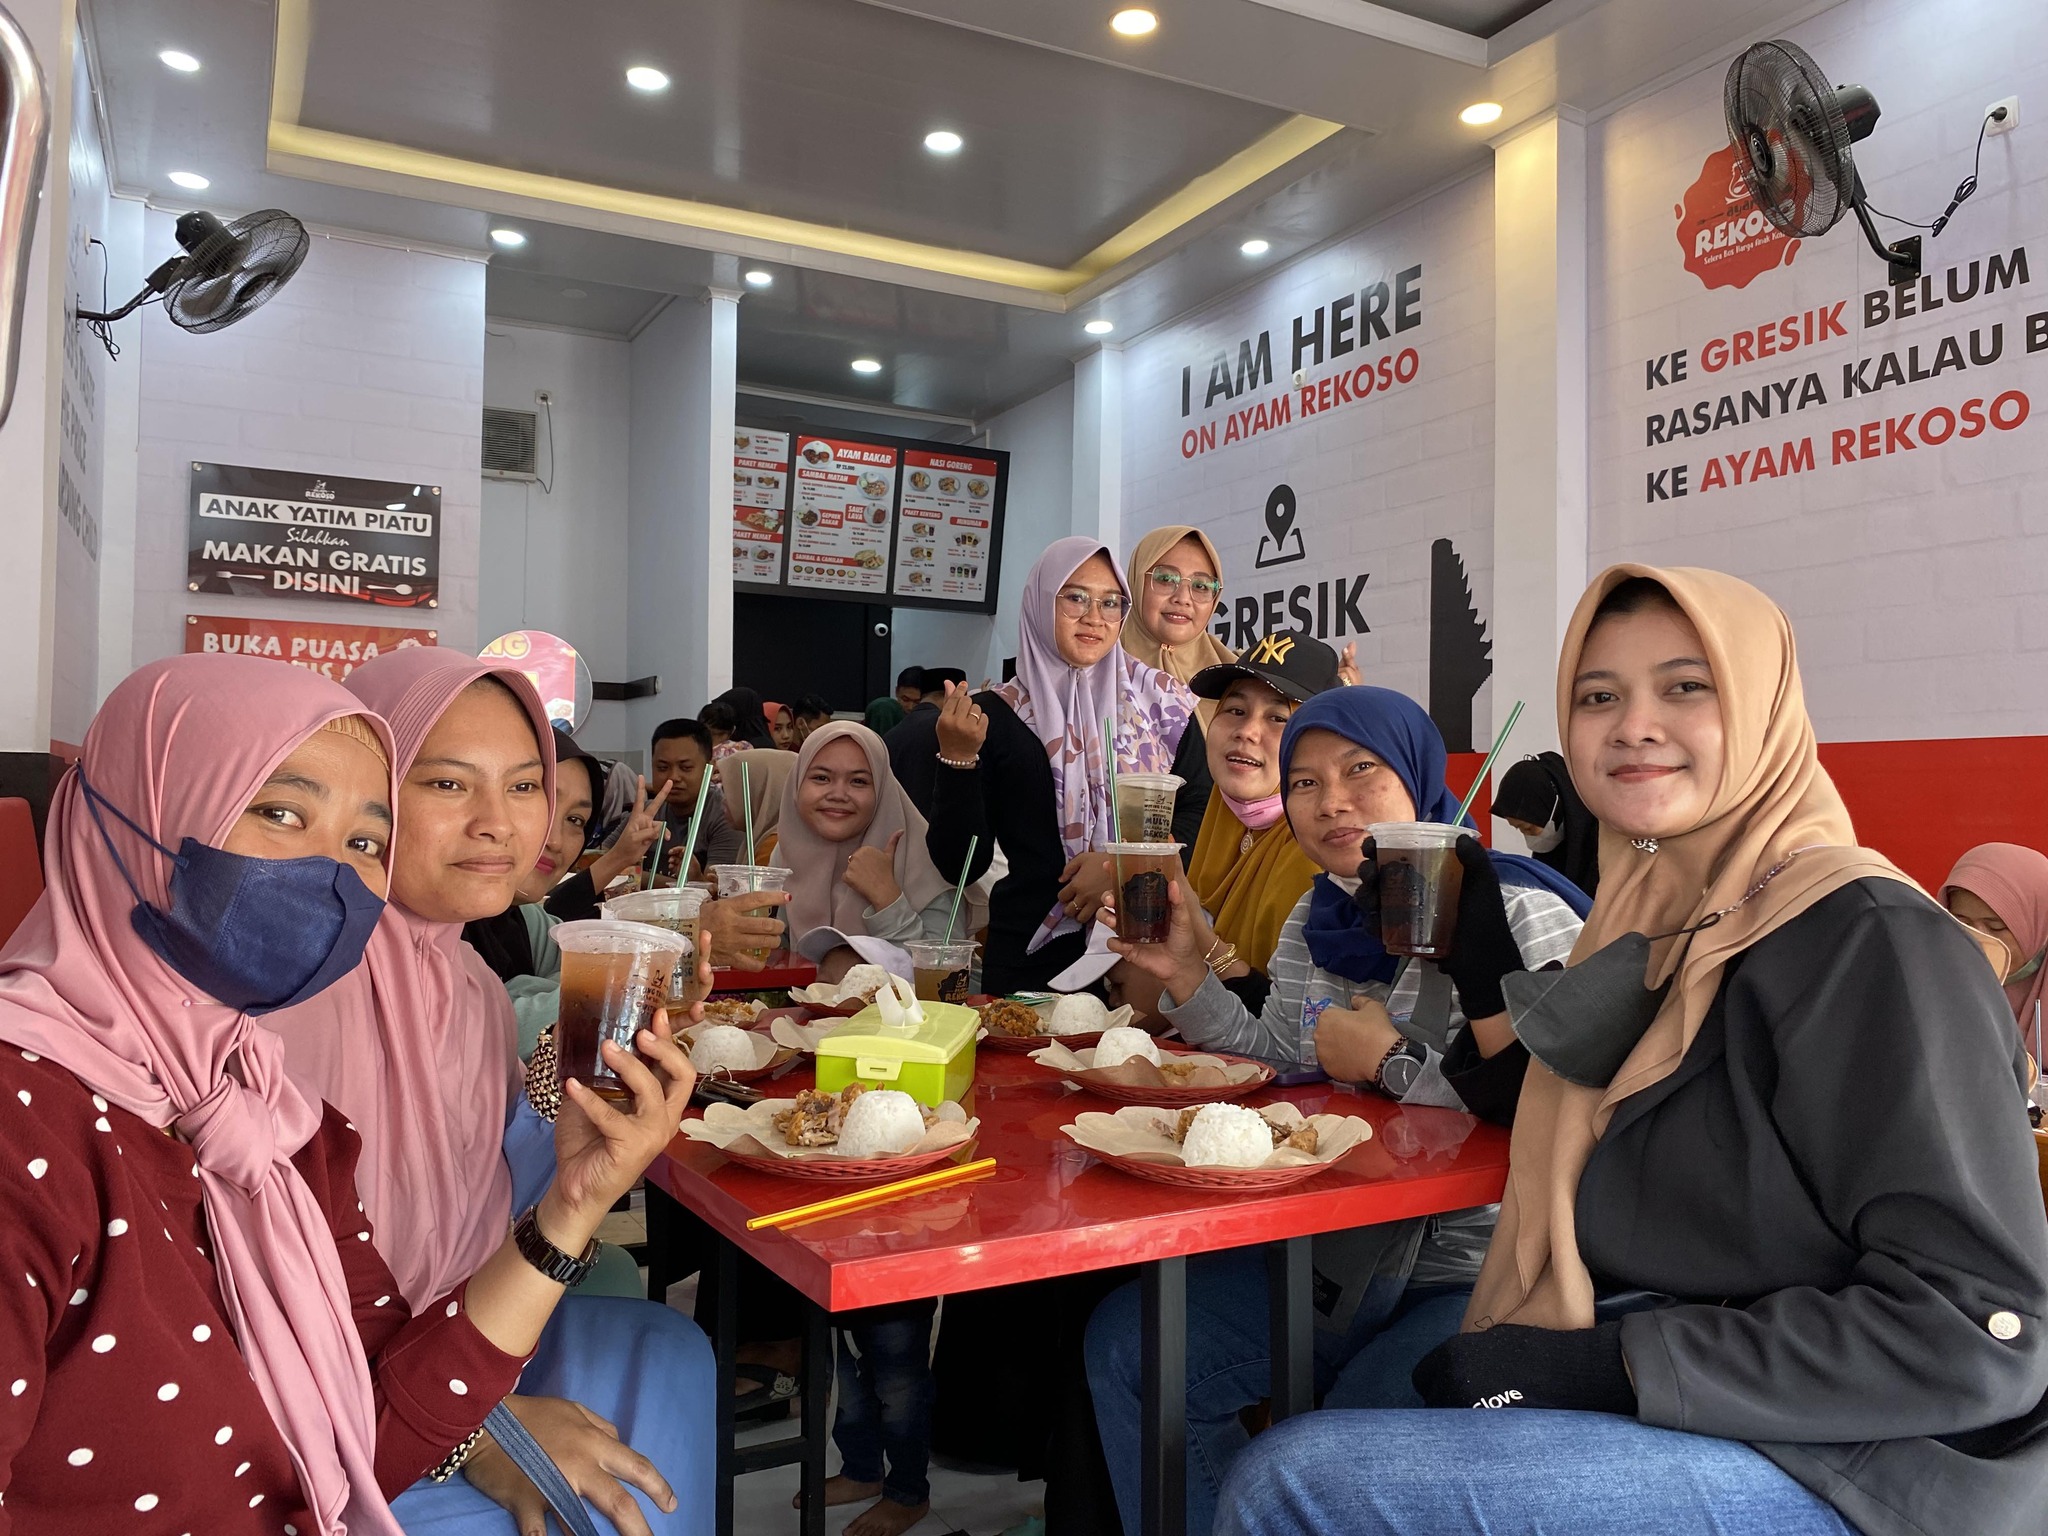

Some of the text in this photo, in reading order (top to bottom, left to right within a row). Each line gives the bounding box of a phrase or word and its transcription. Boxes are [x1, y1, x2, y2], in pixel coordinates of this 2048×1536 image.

[1704, 253, 1722, 265] Selera
[1723, 247, 1735, 258] Bos
[1647, 246, 2030, 391] KE GRESIK BELUM
[1181, 264, 1422, 417] I AM HERE
[1647, 311, 2048, 447] RASANYA KALAU B
[1181, 347, 1419, 459] ON AYAM REKOSO
[837, 448, 892, 464] AYAM BAKAR
[1647, 389, 2030, 503] KE AYAM REKOSO
[738, 459, 757, 468] PAKET
[802, 470, 849, 482] SAMBAL MATAH
[930, 458, 973, 471] NASI GORENG
[205, 498, 428, 533] ANAK YATIM PIATU
[286, 527, 350, 547] Silahkan
[202, 540, 427, 576] MAKAN GRATIS
[273, 570, 360, 595] DISINI
[1206, 573, 1370, 650] GRESIK
[203, 632, 380, 661] BUKA PUASA
[1144, 830, 1169, 839] REKOS
